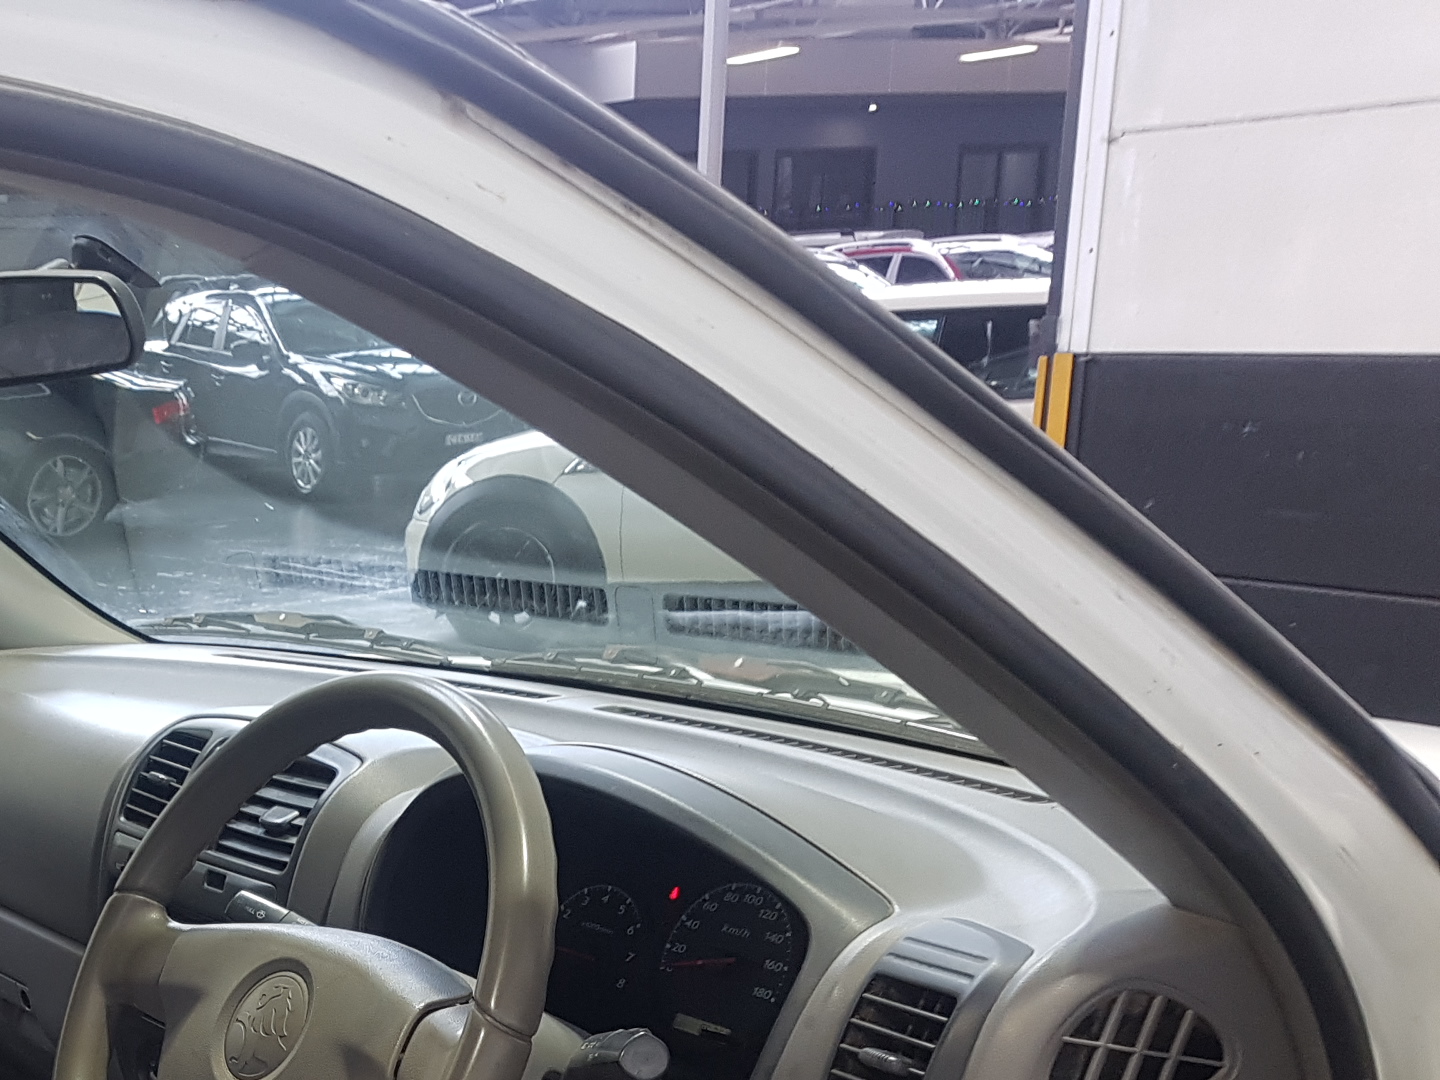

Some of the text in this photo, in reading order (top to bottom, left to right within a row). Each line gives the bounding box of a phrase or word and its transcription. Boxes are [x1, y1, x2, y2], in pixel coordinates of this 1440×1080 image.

[581, 896, 591, 906] 3
[601, 894, 611, 904] 4
[723, 892, 740, 903] 80
[743, 893, 764, 905] 100
[618, 904, 626, 915] 5
[702, 902, 718, 912] 60
[562, 909, 572, 919] 2
[759, 909, 779, 920] 120
[626, 925, 635, 935] 6
[684, 920, 700, 930] 40
[721, 923, 751, 939] km/h
[765, 931, 784, 944] 140
[671, 942, 687, 953] 20
[625, 952, 636, 962] 7
[763, 959, 783, 972] 160
[616, 978, 626, 988] 8
[752, 987, 772, 1000] 180
